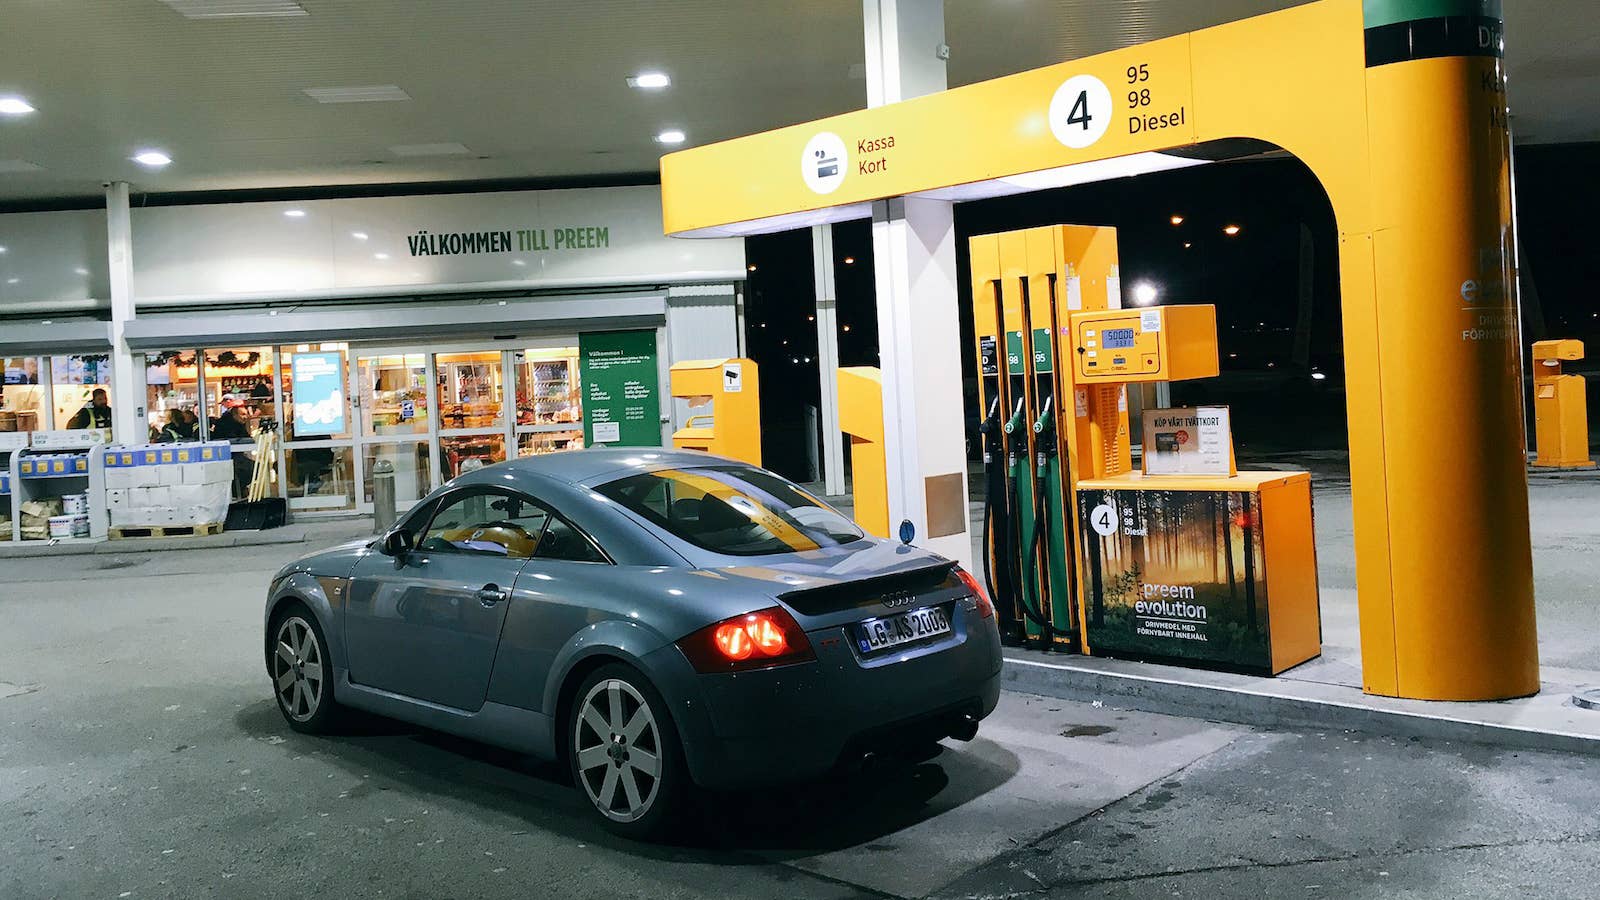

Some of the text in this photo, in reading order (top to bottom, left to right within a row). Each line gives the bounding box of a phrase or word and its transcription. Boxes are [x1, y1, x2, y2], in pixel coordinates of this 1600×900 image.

[1126, 63, 1149, 84] 95
[1128, 88, 1151, 109] 98
[1066, 90, 1093, 131] 4
[1128, 106, 1185, 134] Diesel
[858, 136, 895, 154] Kassa
[859, 157, 887, 175] Kort
[408, 227, 610, 257] VÄLKOMMEN TILL PREEM
[982, 356, 989, 365] D
[1008, 355, 1019, 365] 98
[1035, 353, 1046, 363] 95
[1154, 416, 1219, 428] KÖP VÅRT TVÄTTKORT
[1099, 511, 1110, 529] 4
[1123, 508, 1134, 516] 95
[1124, 517, 1134, 526] 98
[1125, 527, 1147, 536] Diesel
[1143, 583, 1194, 599] preem
[1135, 599, 1206, 619] evolution
[864, 623, 888, 647] LG
[895, 616, 915, 641] AS
[911, 609, 948, 636] 2003
[1136, 627, 1208, 642] FÖRNYBART INNEHÅLL
[1145, 621, 1196, 632] DRIVMEDEL MED
